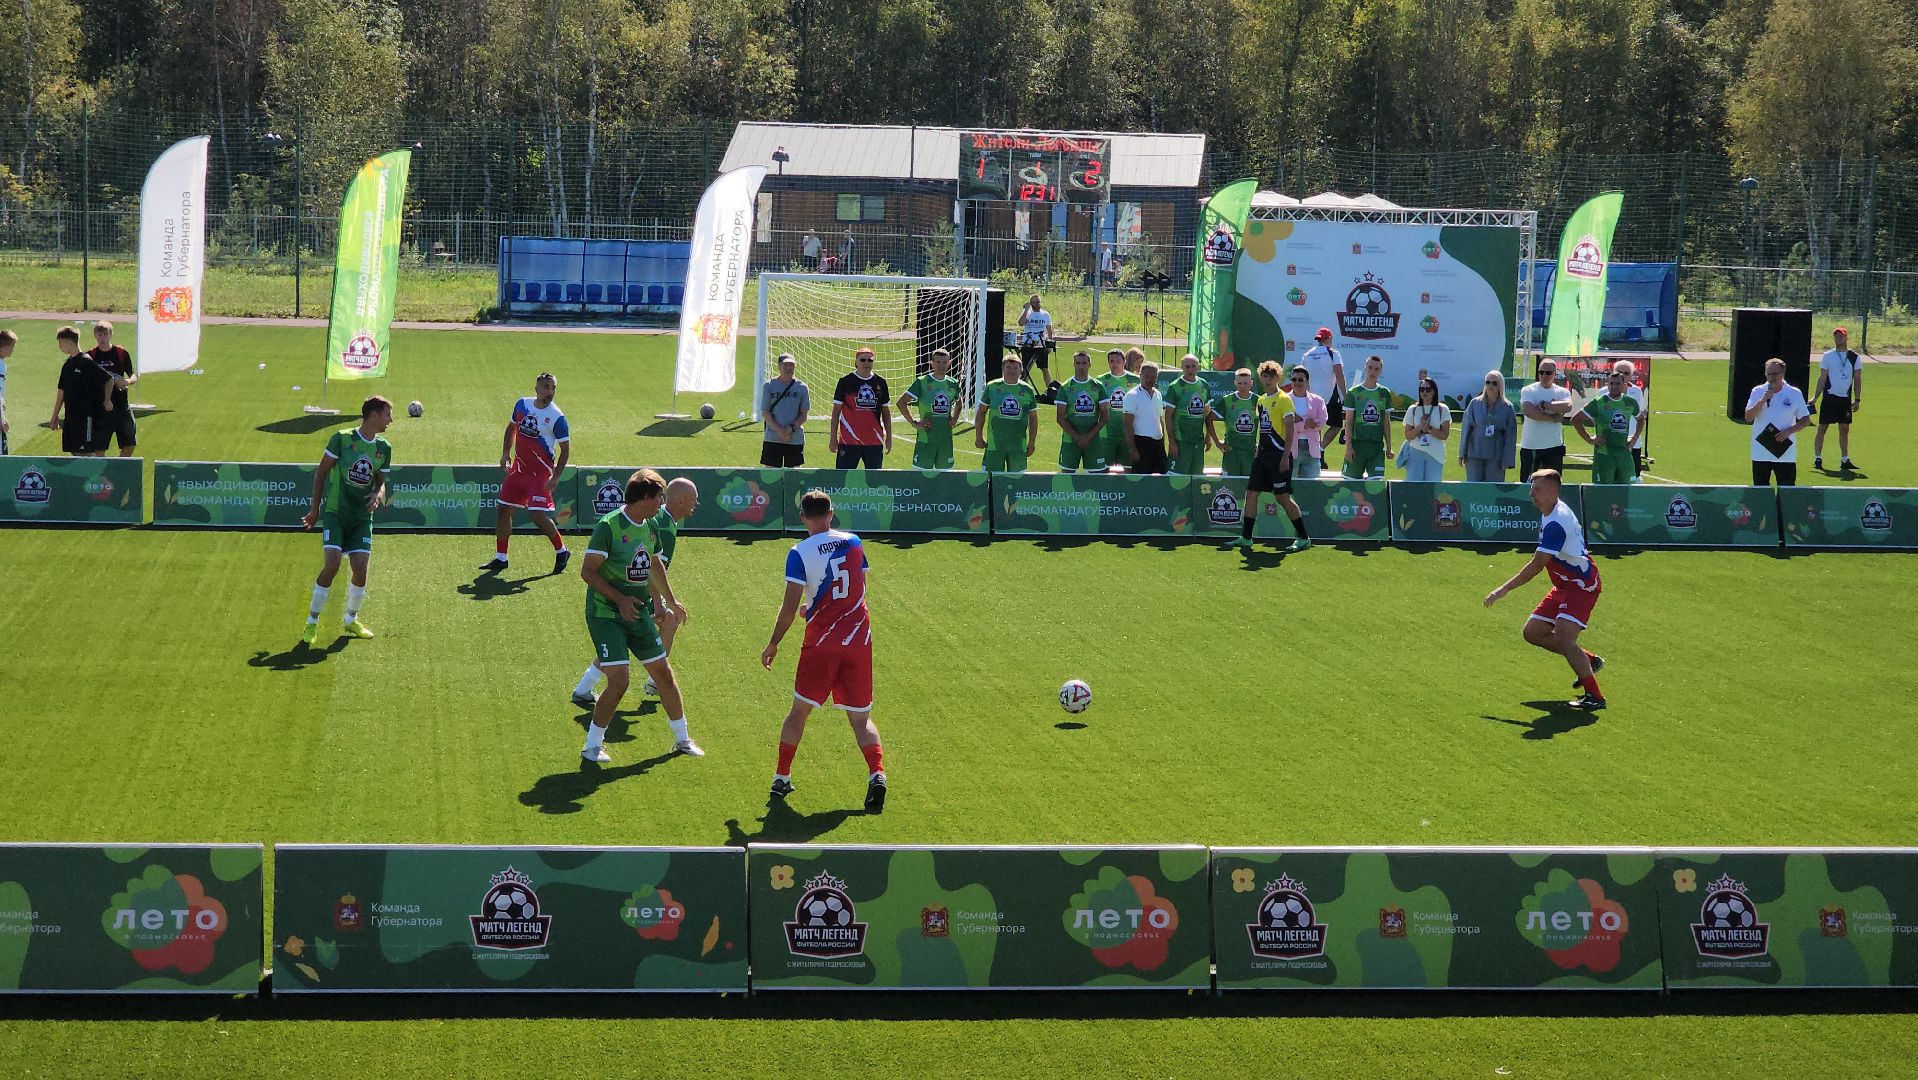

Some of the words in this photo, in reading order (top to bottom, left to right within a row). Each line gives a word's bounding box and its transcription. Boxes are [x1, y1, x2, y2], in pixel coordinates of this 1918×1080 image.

[177, 191, 193, 277] Губернатора
[160, 218, 175, 278] Команда
[725, 209, 745, 302] ГУБЕРНАТОРА
[708, 233, 725, 301] КОМАНДА
[1343, 316, 1364, 326] МАТЧ
[1365, 316, 1395, 328] ЛЕГЕНД
[177, 480, 296, 492] #ВЫХОДИВОДВОР
[392, 483, 502, 495] #ВЫХОДИВОДВО
[177, 495, 327, 507] #КОМАНДАГУБЕРНАТ
[1014, 491, 1126, 502] #ВЫХОДИВОДВОР
[1015, 505, 1168, 517] #КОМАНДАГУБЕРНАТОРА
[1470, 503, 1521, 514] Команда
[1471, 516, 1541, 529] Губернатор
[830, 556, 849, 600] 5
[601, 644, 609, 658] 3
[371, 903, 420, 914] Команда
[626, 907, 681, 919] лето
[112, 908, 219, 931] лето
[957, 910, 1004, 920] Команда
[1073, 908, 1171, 930] лето
[1413, 911, 1459, 922] Команда
[1526, 910, 1622, 931] лето
[1852, 911, 1897, 921] Команда
[371, 916, 442, 928] Губернатора
[480, 922, 505, 933] МАТЧ
[507, 922, 542, 933] ЛЕГЕНД
[794, 928, 820, 940] МАТЧ
[822, 928, 858, 941] ЛЕГЕНД
[957, 923, 1026, 935] Губернатора
[1414, 924, 1481, 935] Губернатора
[1257, 930, 1282, 941] МАТЧ
[1284, 930, 1320, 942] ЛЕГЕНД
[1701, 930, 1726, 940] МАТЧ
[1728, 930, 1763, 941] ЛЕГЕНД
